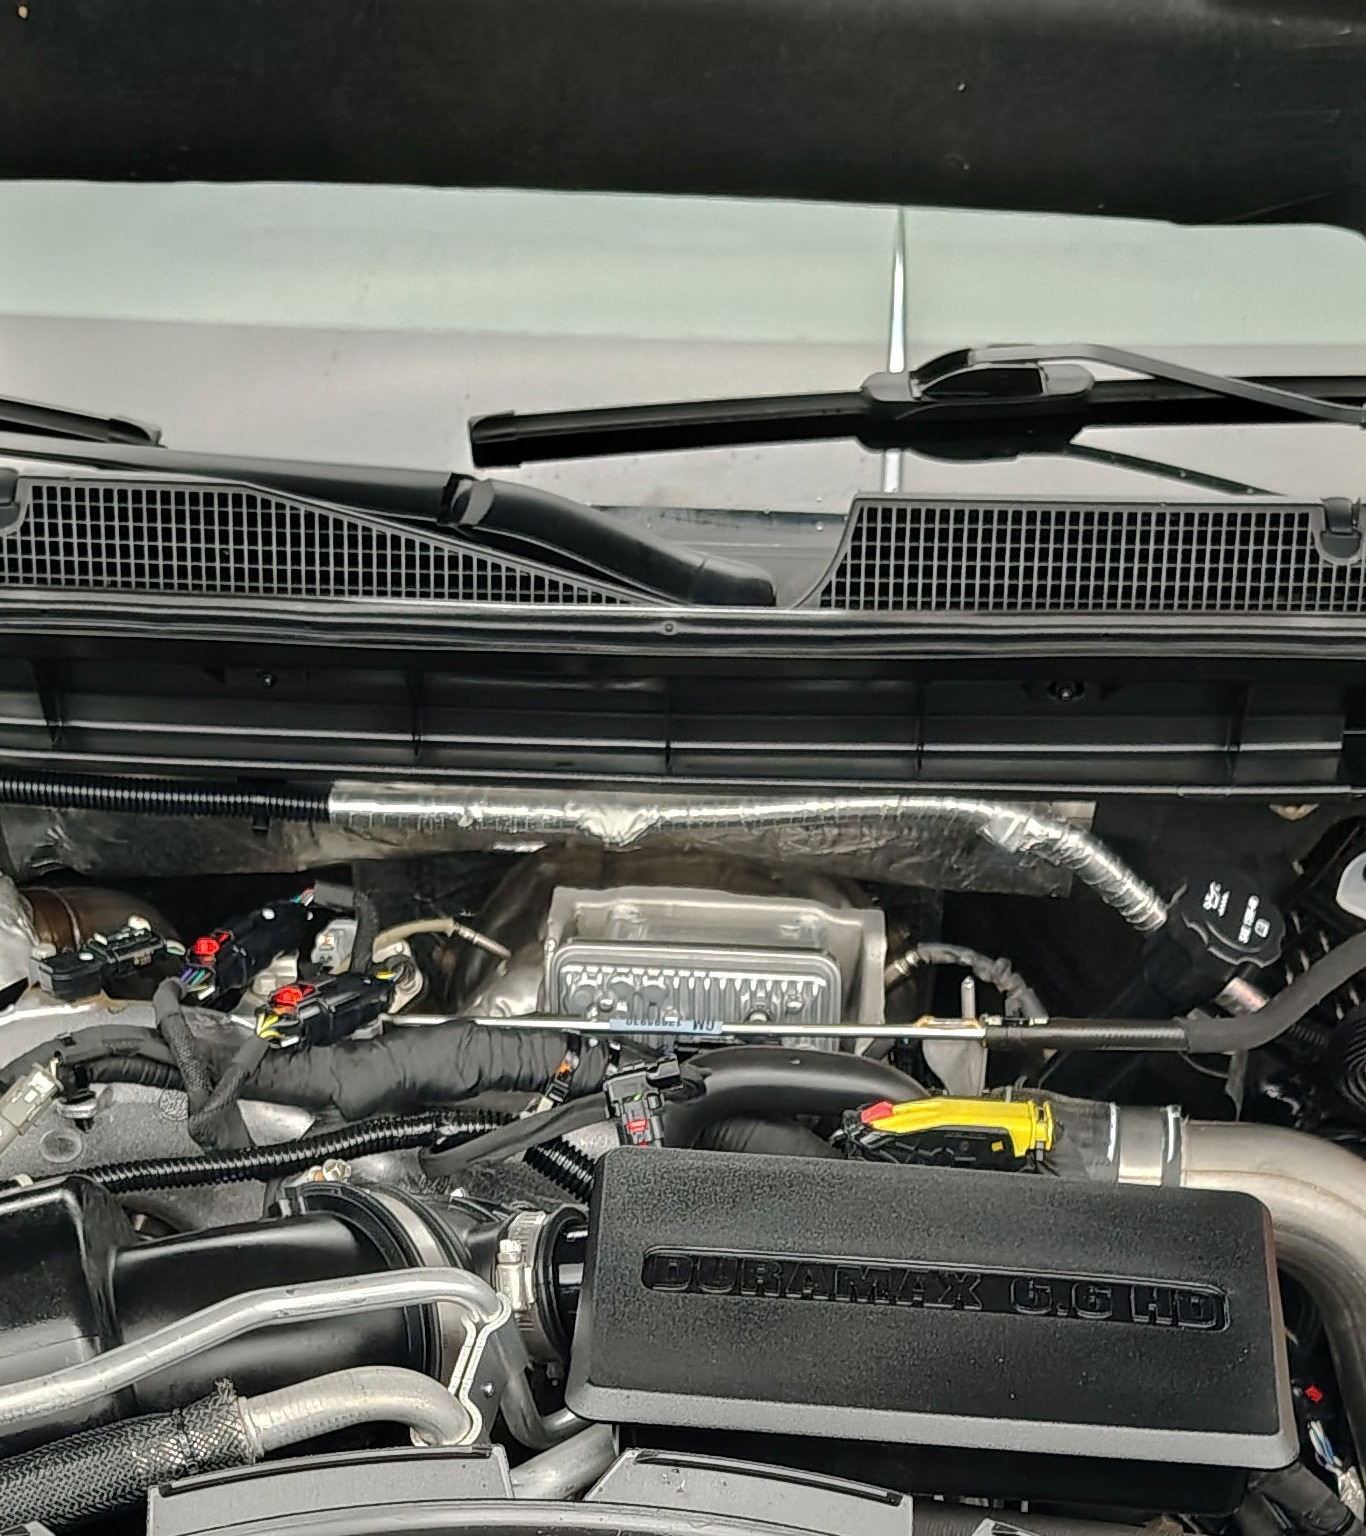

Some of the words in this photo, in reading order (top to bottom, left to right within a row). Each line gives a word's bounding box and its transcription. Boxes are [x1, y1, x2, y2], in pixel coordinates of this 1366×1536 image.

[649, 1253, 982, 1310] DURAMAX
[1009, 1277, 1113, 1319] 6.6
[1130, 1285, 1218, 1328] HD
